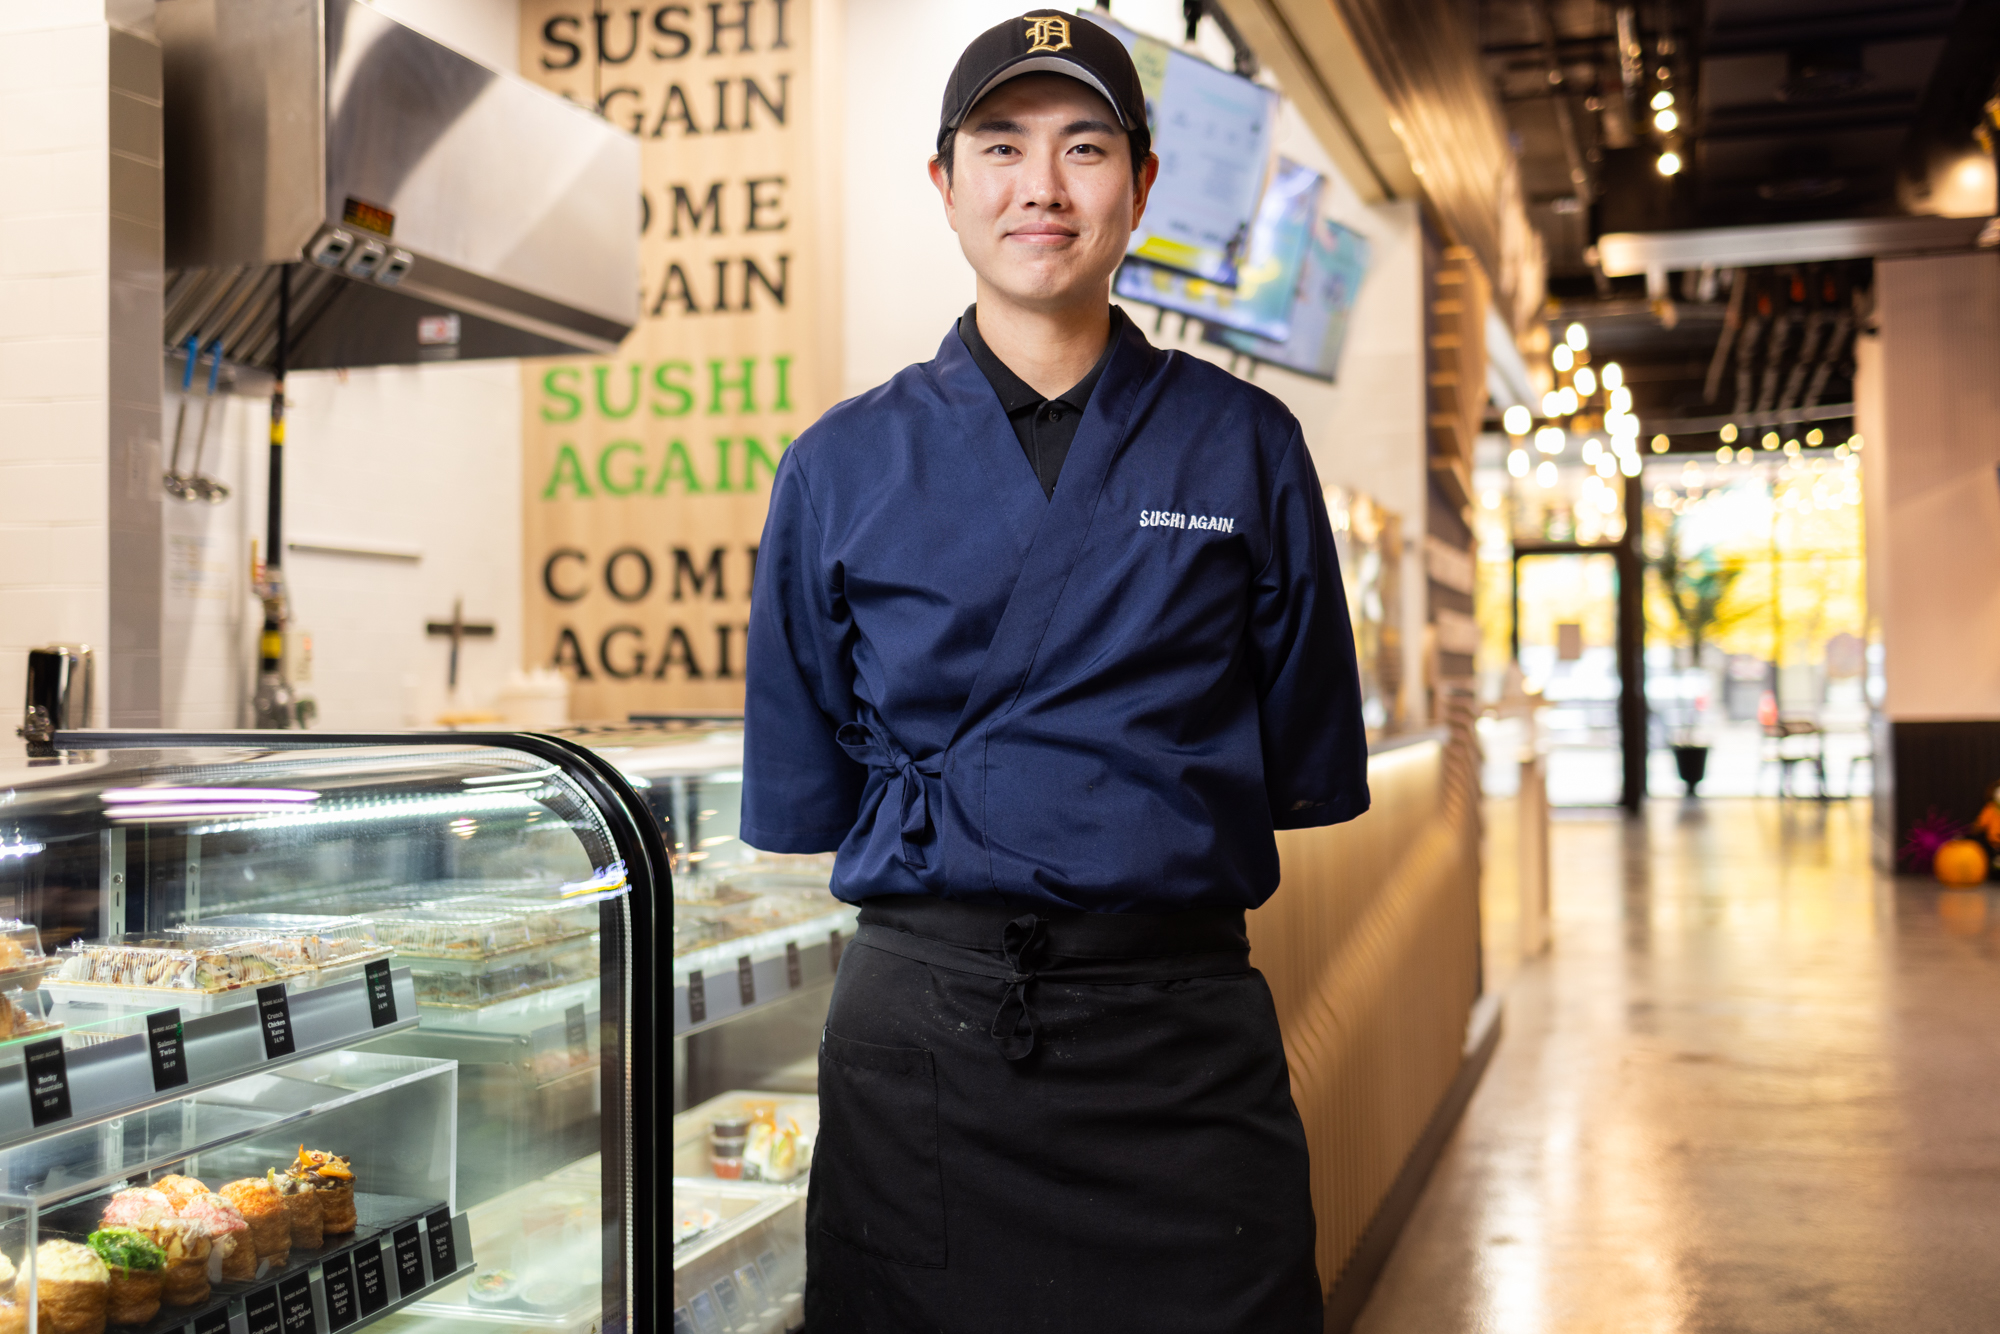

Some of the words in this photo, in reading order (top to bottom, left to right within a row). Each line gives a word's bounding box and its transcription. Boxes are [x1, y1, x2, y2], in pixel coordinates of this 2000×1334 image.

[540, 0, 790, 70] SUSHI
[1023, 15, 1073, 54] D
[566, 73, 788, 139] GAIN
[640, 175, 788, 238] ME
[641, 254, 788, 316] AIN
[540, 356, 792, 424] SUSHI
[542, 435, 792, 501] AGAIN
[1139, 510, 1185, 529] SUSHI
[1188, 515, 1234, 534] AGAIN
[552, 623, 750, 681] AGAI
[267, 1011, 284, 1020] Crunch
[268, 1020, 286, 1028] Chicken
[157, 1039, 177, 1048] Salmon
[160, 1048, 176, 1057] Twice
[38, 1074, 58, 1084] Rocky
[35, 1082, 64, 1096] Mountain
[436, 1236, 446, 1245] Spicy
[437, 1244, 448, 1252] Tuna
[403, 1251, 414, 1260] Spicy
[402, 1258, 418, 1269] Salmon
[364, 1269, 376, 1280] Squid
[334, 1282, 346, 1292] Tako
[366, 1277, 378, 1288] Salad
[332, 1288, 348, 1300] Wasabi
[291, 1303, 304, 1313] Spicy
[335, 1298, 348, 1308] Salad
[286, 1314, 298, 1325] Crab
[298, 1308, 312, 1318] Salad
[264, 1322, 278, 1333] Salad
